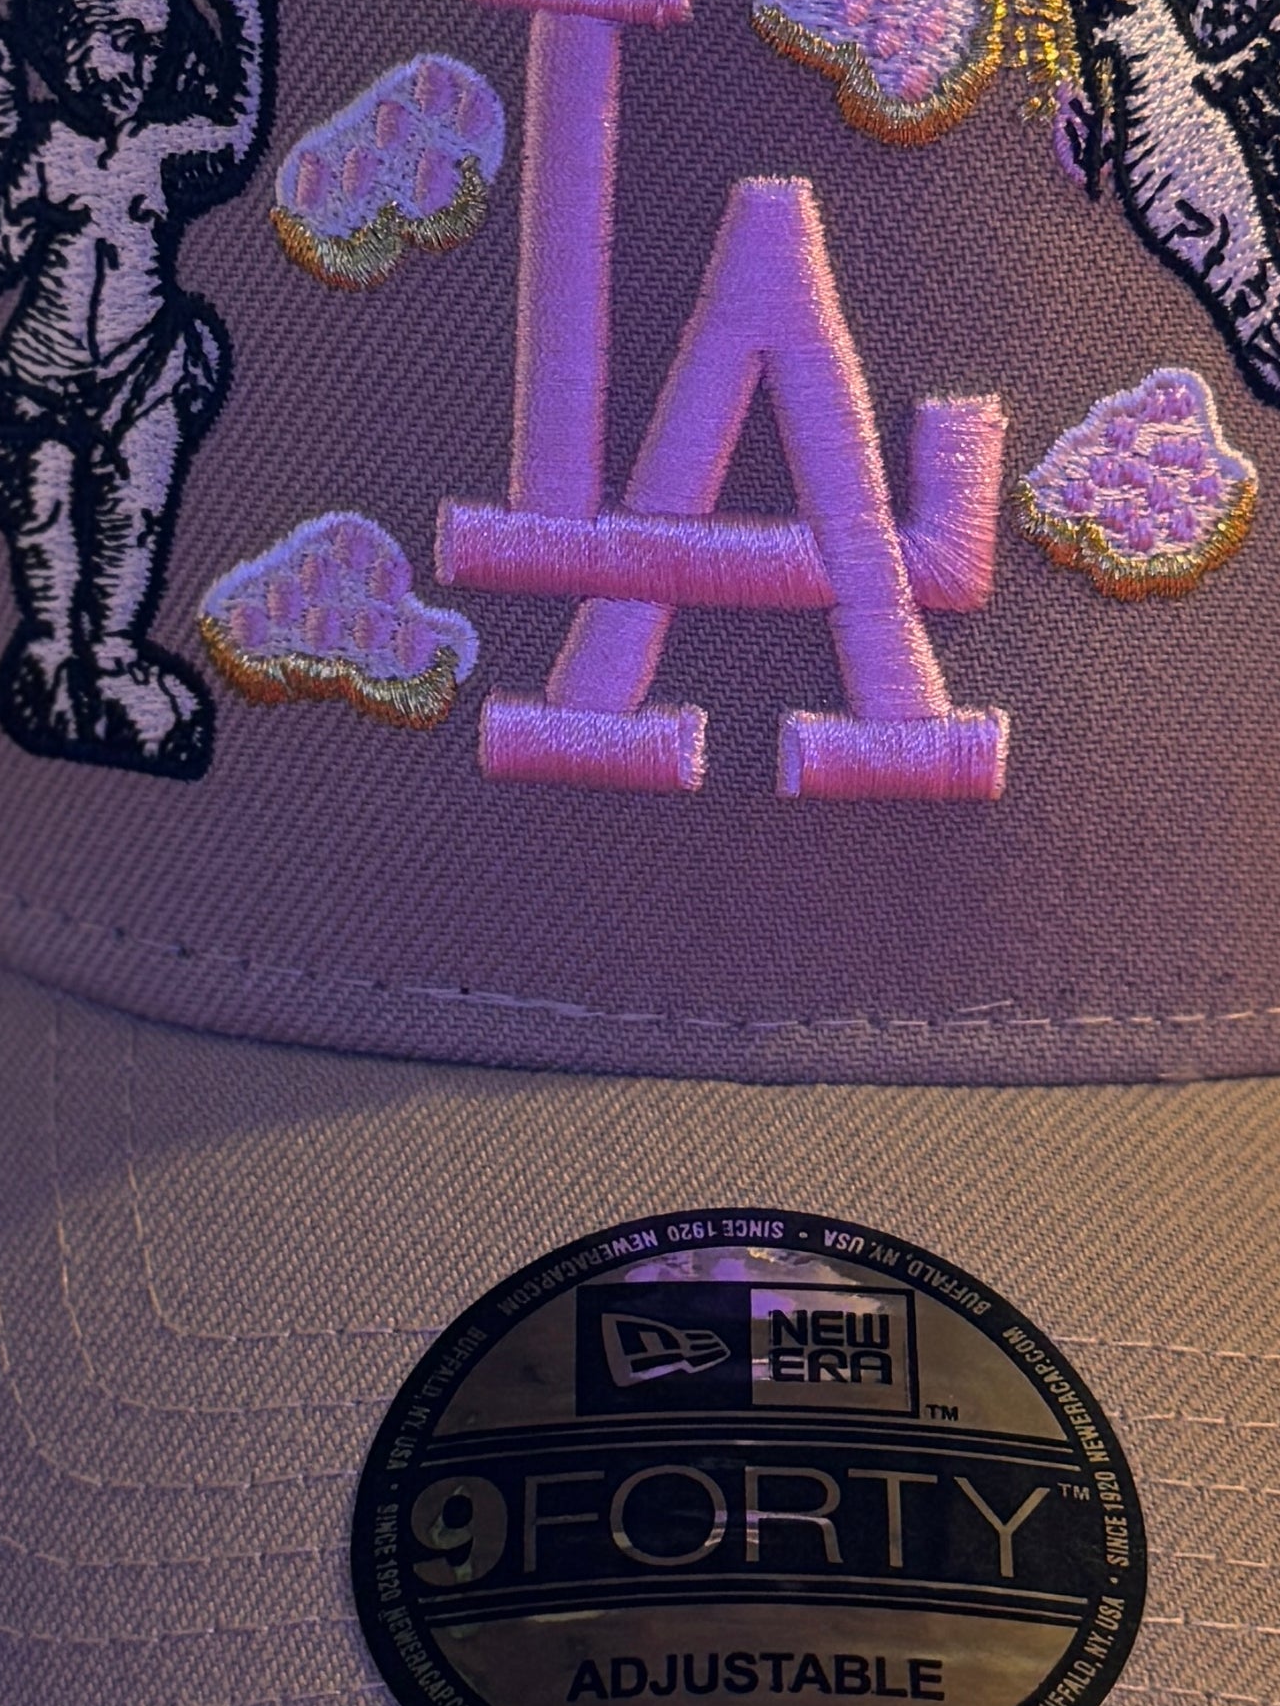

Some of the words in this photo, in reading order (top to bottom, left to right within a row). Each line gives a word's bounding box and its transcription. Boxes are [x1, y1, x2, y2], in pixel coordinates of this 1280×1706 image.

[666, 1222, 718, 1243] 1920
[722, 1219, 786, 1241] SINCE
[823, 1228, 866, 1255] USA
[496, 1229, 658, 1317] NEWERACAP.COM
[769, 1309, 889, 1349] NEW
[770, 1347, 892, 1385] ERA
[1002, 1326, 1110, 1462] NEWERACAP.COM
[386, 1435, 418, 1470] USA
[1095, 1471, 1124, 1510] 1920
[373, 1503, 400, 1556] SINCE
[410, 1465, 1051, 1586] 9FORTY
[1105, 1511, 1129, 1567] SINCE
[376, 1558, 402, 1603] 1920
[1095, 1595, 1126, 1631] USA
[567, 1651, 945, 1702] ADJUSTABLE
